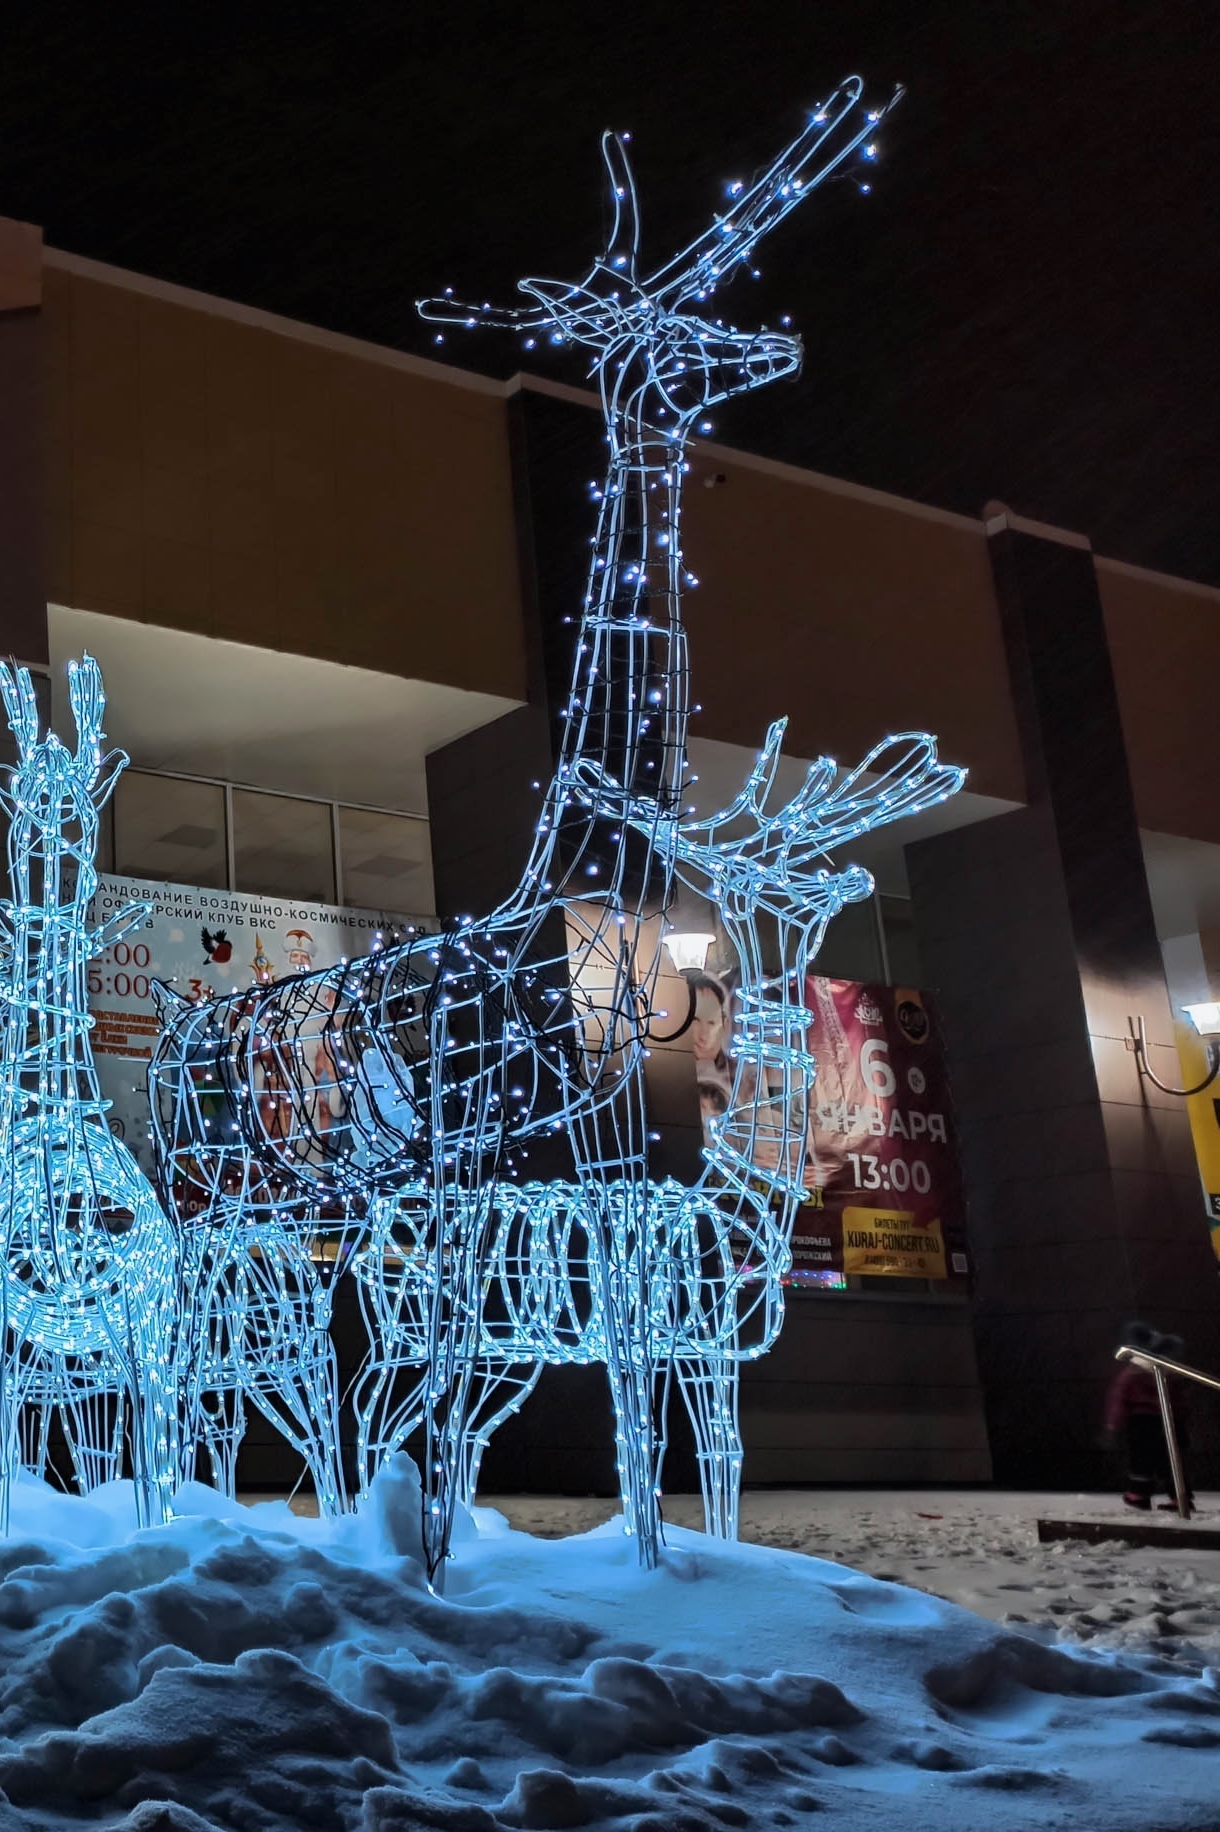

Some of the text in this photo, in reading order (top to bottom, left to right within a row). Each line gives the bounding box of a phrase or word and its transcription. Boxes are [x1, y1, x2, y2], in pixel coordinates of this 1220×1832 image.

[199, 897, 394, 932] ВОЗДУШНО-КОСМИЧЕСКИХ
[209, 912, 245, 926] КЛУБ
[250, 917, 277, 930] ВКС
[860, 1038, 897, 1098] 6
[815, 1100, 948, 1145] ЯНВАРЯ
[847, 1152, 931, 1195] 13:00
[846, 1230, 941, 1255] KURAJ-CONCERT.RU
